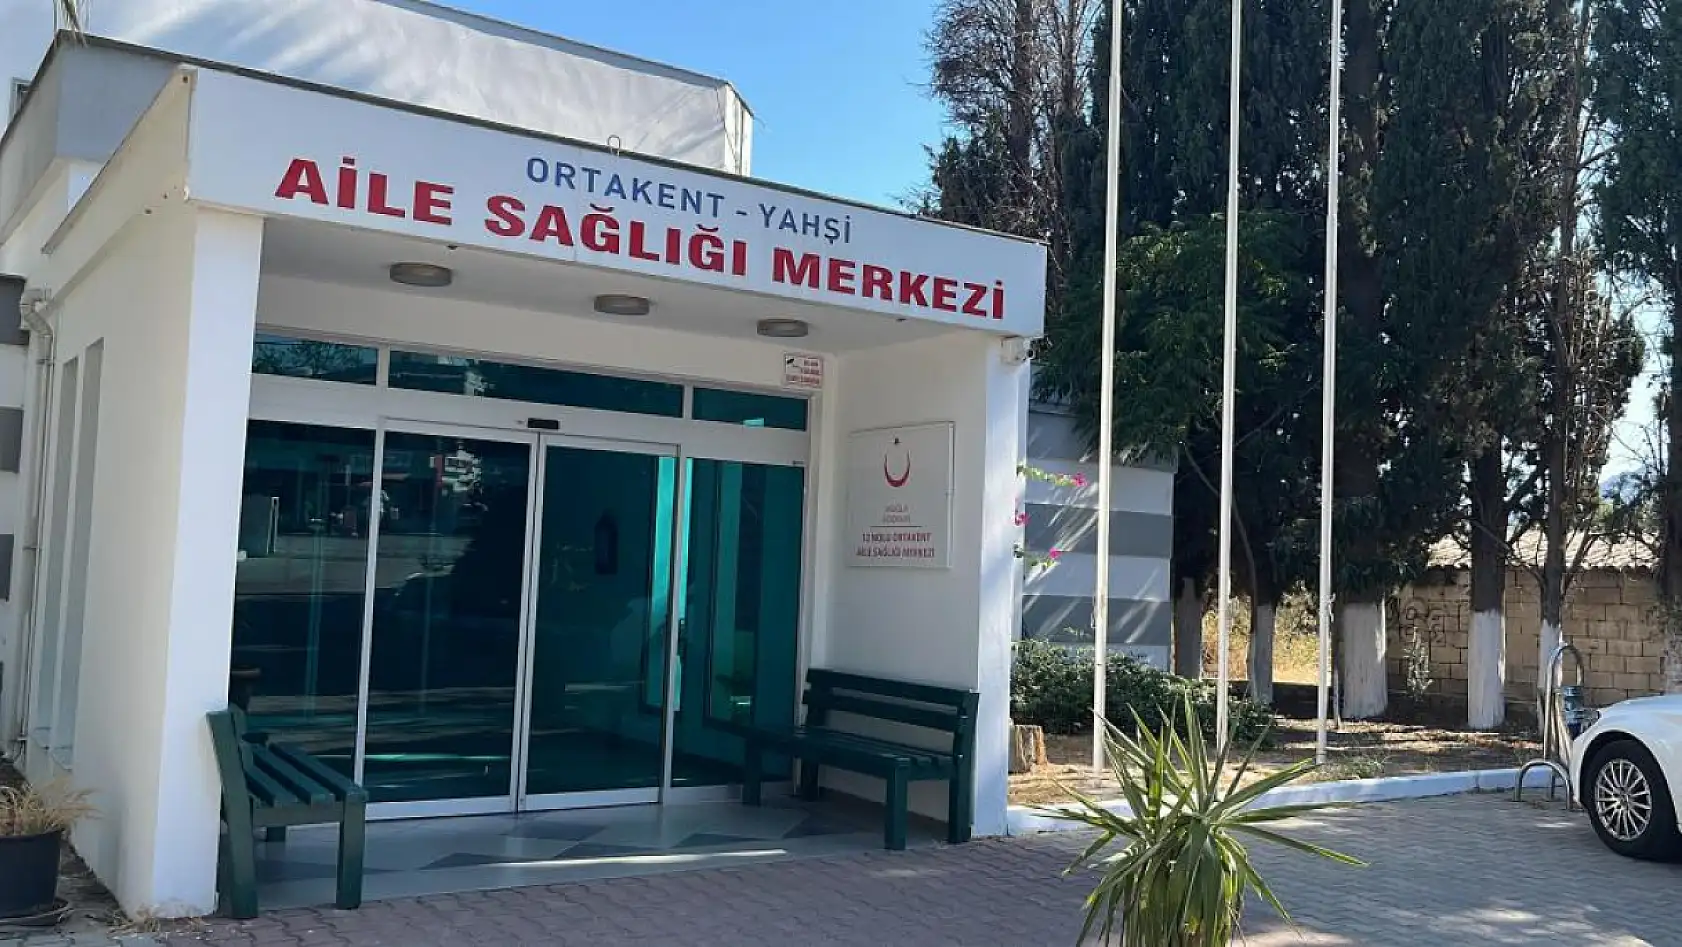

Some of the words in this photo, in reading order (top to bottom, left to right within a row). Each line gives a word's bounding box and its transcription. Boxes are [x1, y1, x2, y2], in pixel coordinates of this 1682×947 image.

[274, 156, 455, 225] AİLE
[484, 194, 748, 277] SAĞLIĞI
[772, 247, 1004, 320] MERKEZİ
[527, 157, 725, 218] ORTAKENT
[758, 203, 851, 245] YAHŞİ
[893, 532, 932, 542] ORTAKENT
